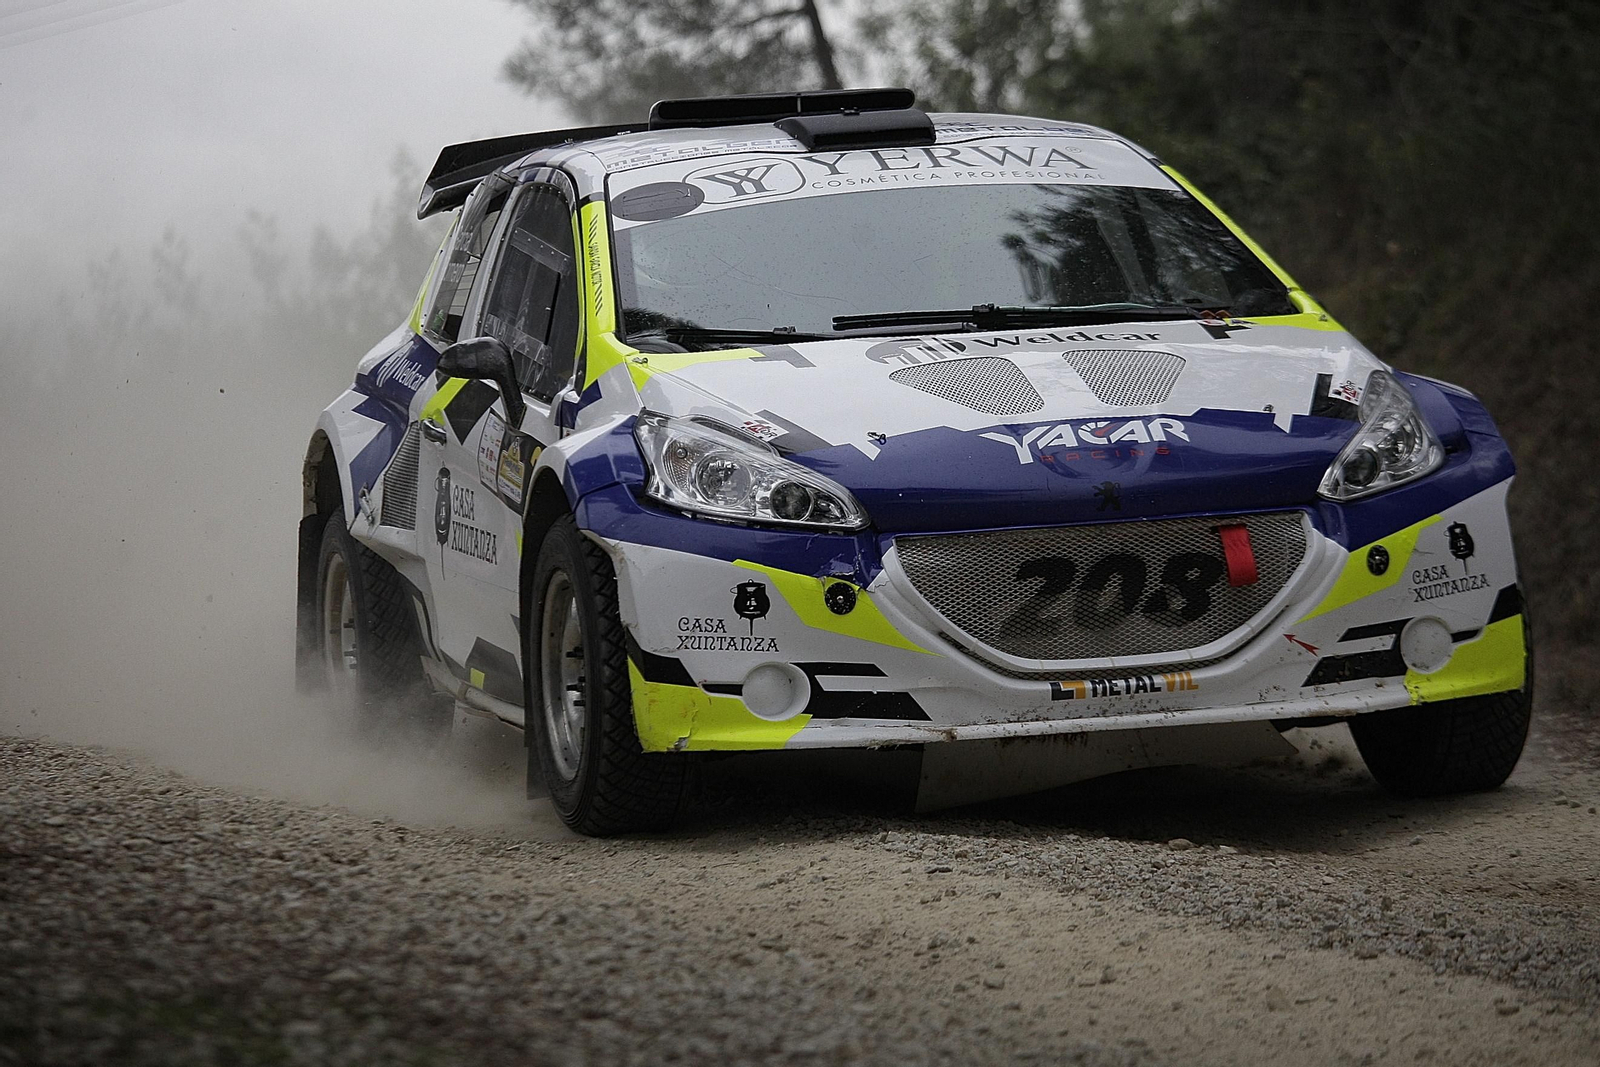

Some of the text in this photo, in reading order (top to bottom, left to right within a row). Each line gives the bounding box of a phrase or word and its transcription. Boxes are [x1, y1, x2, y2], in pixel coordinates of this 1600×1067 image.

[794, 145, 1097, 176] YERWA
[811, 170, 1106, 189] COSMÉTICA PROFESIONAL
[971, 331, 1161, 348] Weldcar
[977, 417, 1190, 465] YACAR
[1039, 447, 1170, 462] RACING
[453, 485, 475, 520] CASA
[451, 520, 498, 565] XUNTANZA
[1412, 564, 1449, 585] CASA
[1000, 552, 1224, 637] 208
[1413, 573, 1491, 603] XUNTANZA
[678, 617, 727, 633] CASA
[676, 635, 779, 652] XUNTANZA
